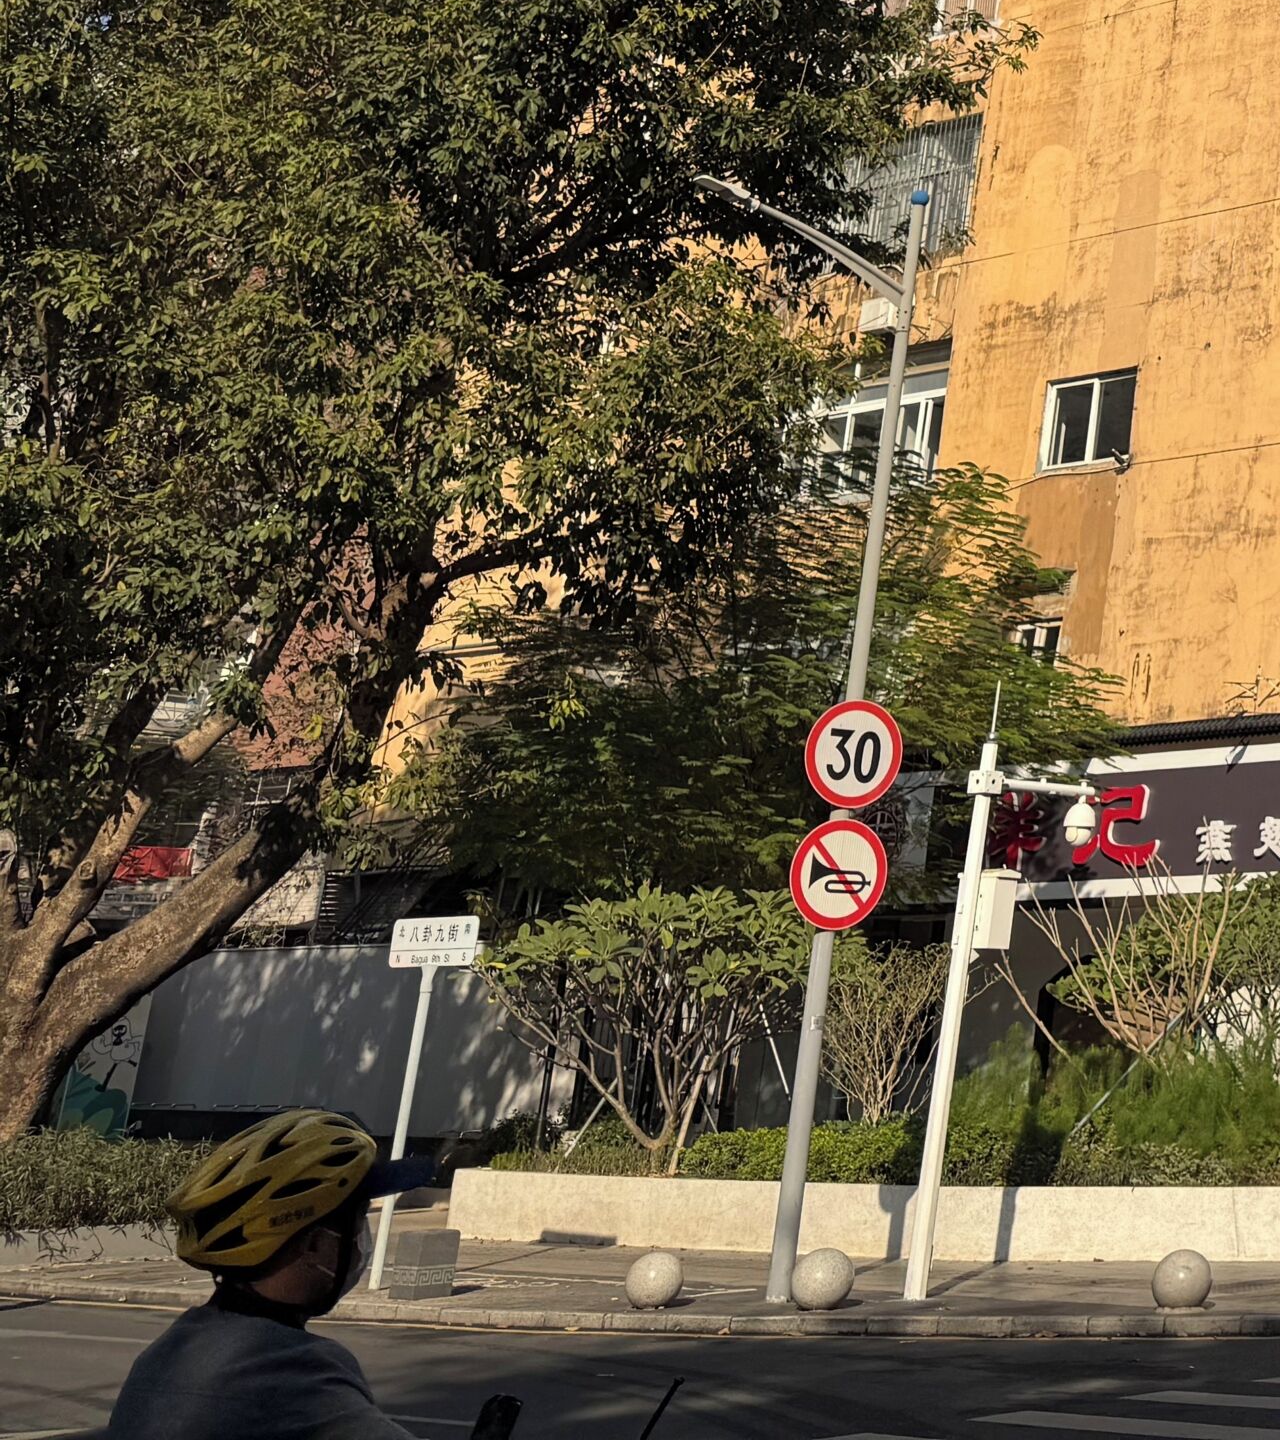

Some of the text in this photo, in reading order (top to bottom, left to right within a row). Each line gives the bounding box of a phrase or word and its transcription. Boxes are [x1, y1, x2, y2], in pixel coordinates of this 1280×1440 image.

[826, 728, 881, 784] 30
[409, 923, 459, 943] 八卦九街
